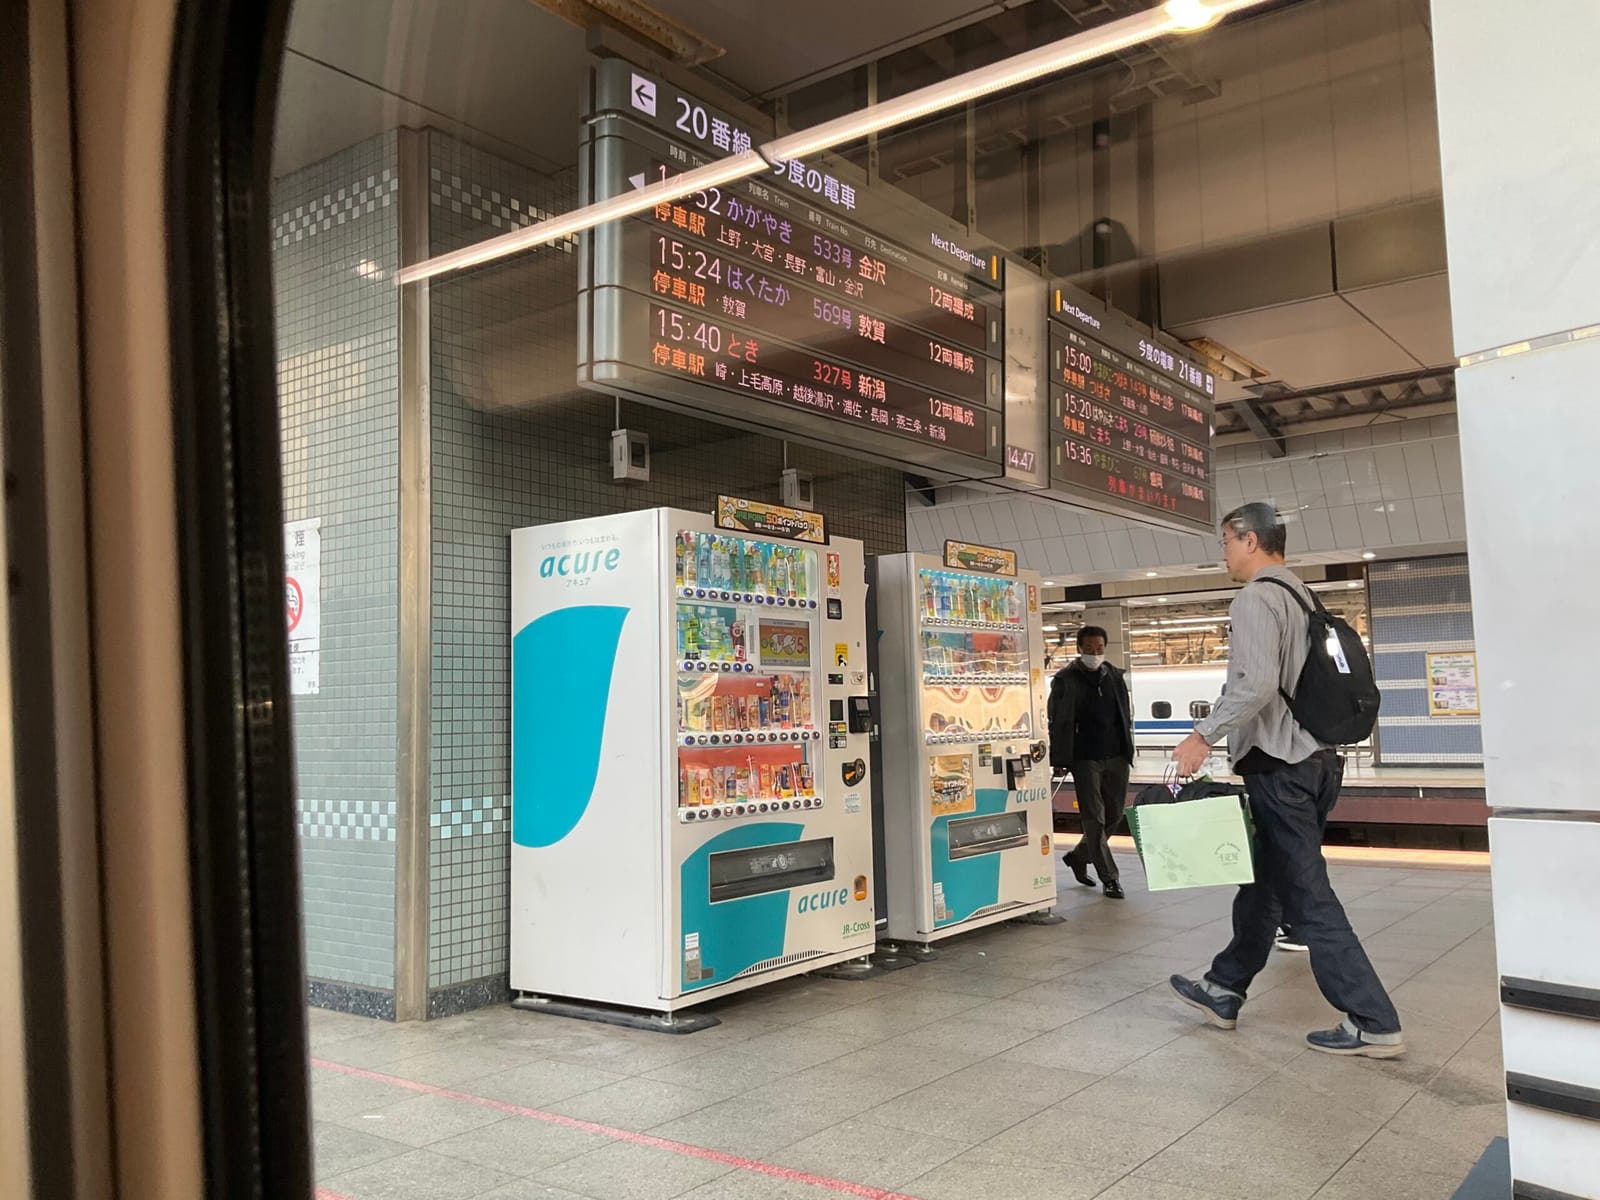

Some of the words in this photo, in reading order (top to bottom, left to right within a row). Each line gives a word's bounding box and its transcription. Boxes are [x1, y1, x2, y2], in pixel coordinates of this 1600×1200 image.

[675, 97, 751, 158] 20番線
[771, 152, 856, 210] 今度の電車
[655, 201, 706, 237] 停車駅
[727, 197, 793, 244] かがやき
[813, 234, 852, 269] 533号
[858, 255, 886, 286] 金沢
[929, 286, 974, 321] 12両編成
[931, 232, 949, 252] Next
[950, 242, 986, 269] Departure
[652, 269, 706, 307] 停車駅
[658, 237, 722, 284] 15:24
[727, 264, 790, 306] はくたか
[813, 297, 852, 329] 569号
[858, 314, 886, 344] 敦賀
[929, 342, 974, 375] 12両編成
[1062, 300, 1075, 315] Next
[1075, 307, 1100, 329] Departure
[652, 342, 705, 377] 停車駅
[658, 309, 721, 352] 15:40
[727, 333, 759, 363] とき
[813, 361, 852, 390] 327号
[858, 373, 886, 403] 新潟
[929, 397, 974, 427] 12両編成
[1064, 345, 1092, 374] 15:00
[1179, 360, 1202, 388] 21番線
[1064, 392, 1092, 419] 15:20
[1089, 424, 1111, 446] こまち
[1007, 446, 1034, 471] 14:47
[1064, 440, 1092, 465] 15:36
[539, 547, 621, 579] acure
[1016, 786, 1047, 804] acure
[797, 888, 848, 914] acure
[842, 921, 870, 935] JR-Cross
